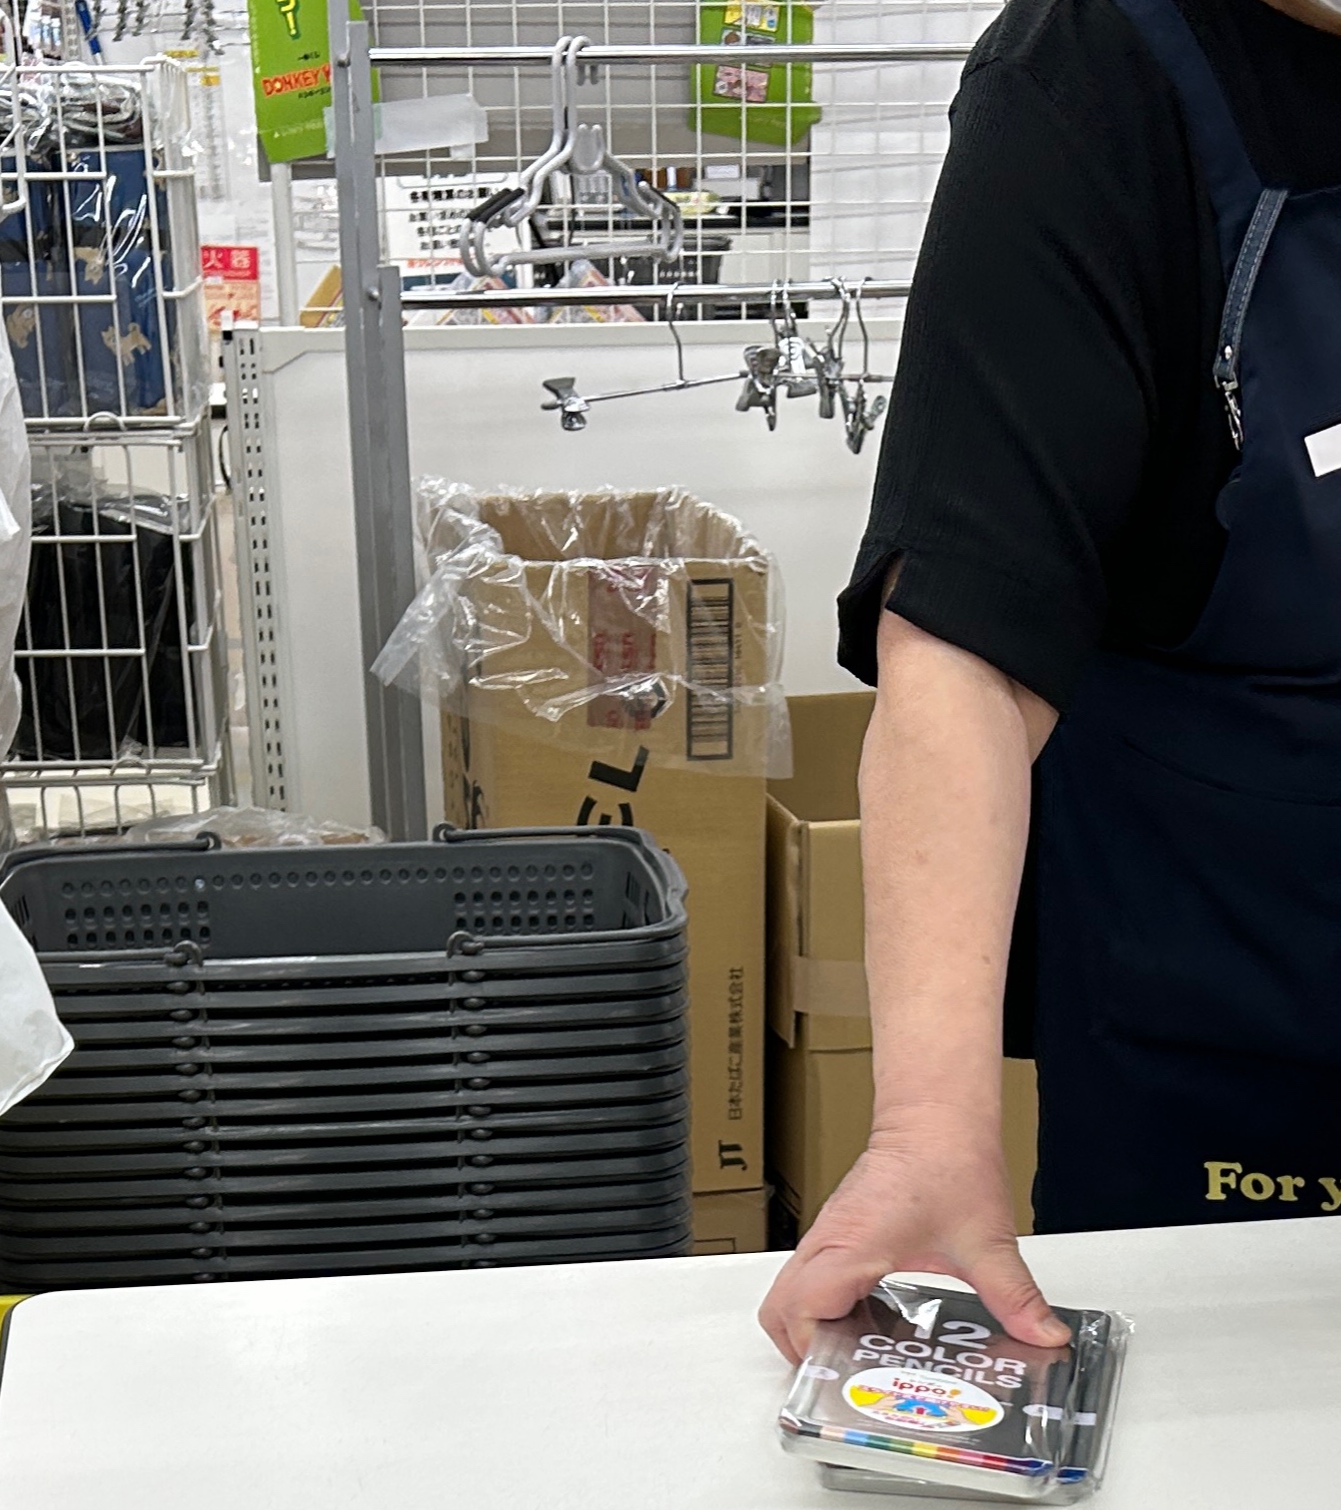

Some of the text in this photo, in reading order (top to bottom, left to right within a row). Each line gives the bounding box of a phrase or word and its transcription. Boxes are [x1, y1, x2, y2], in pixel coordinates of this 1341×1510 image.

[719, 1139, 749, 1171] JT
[1203, 1160, 1306, 1201] For
[859, 1333, 1028, 1376] COLOR
